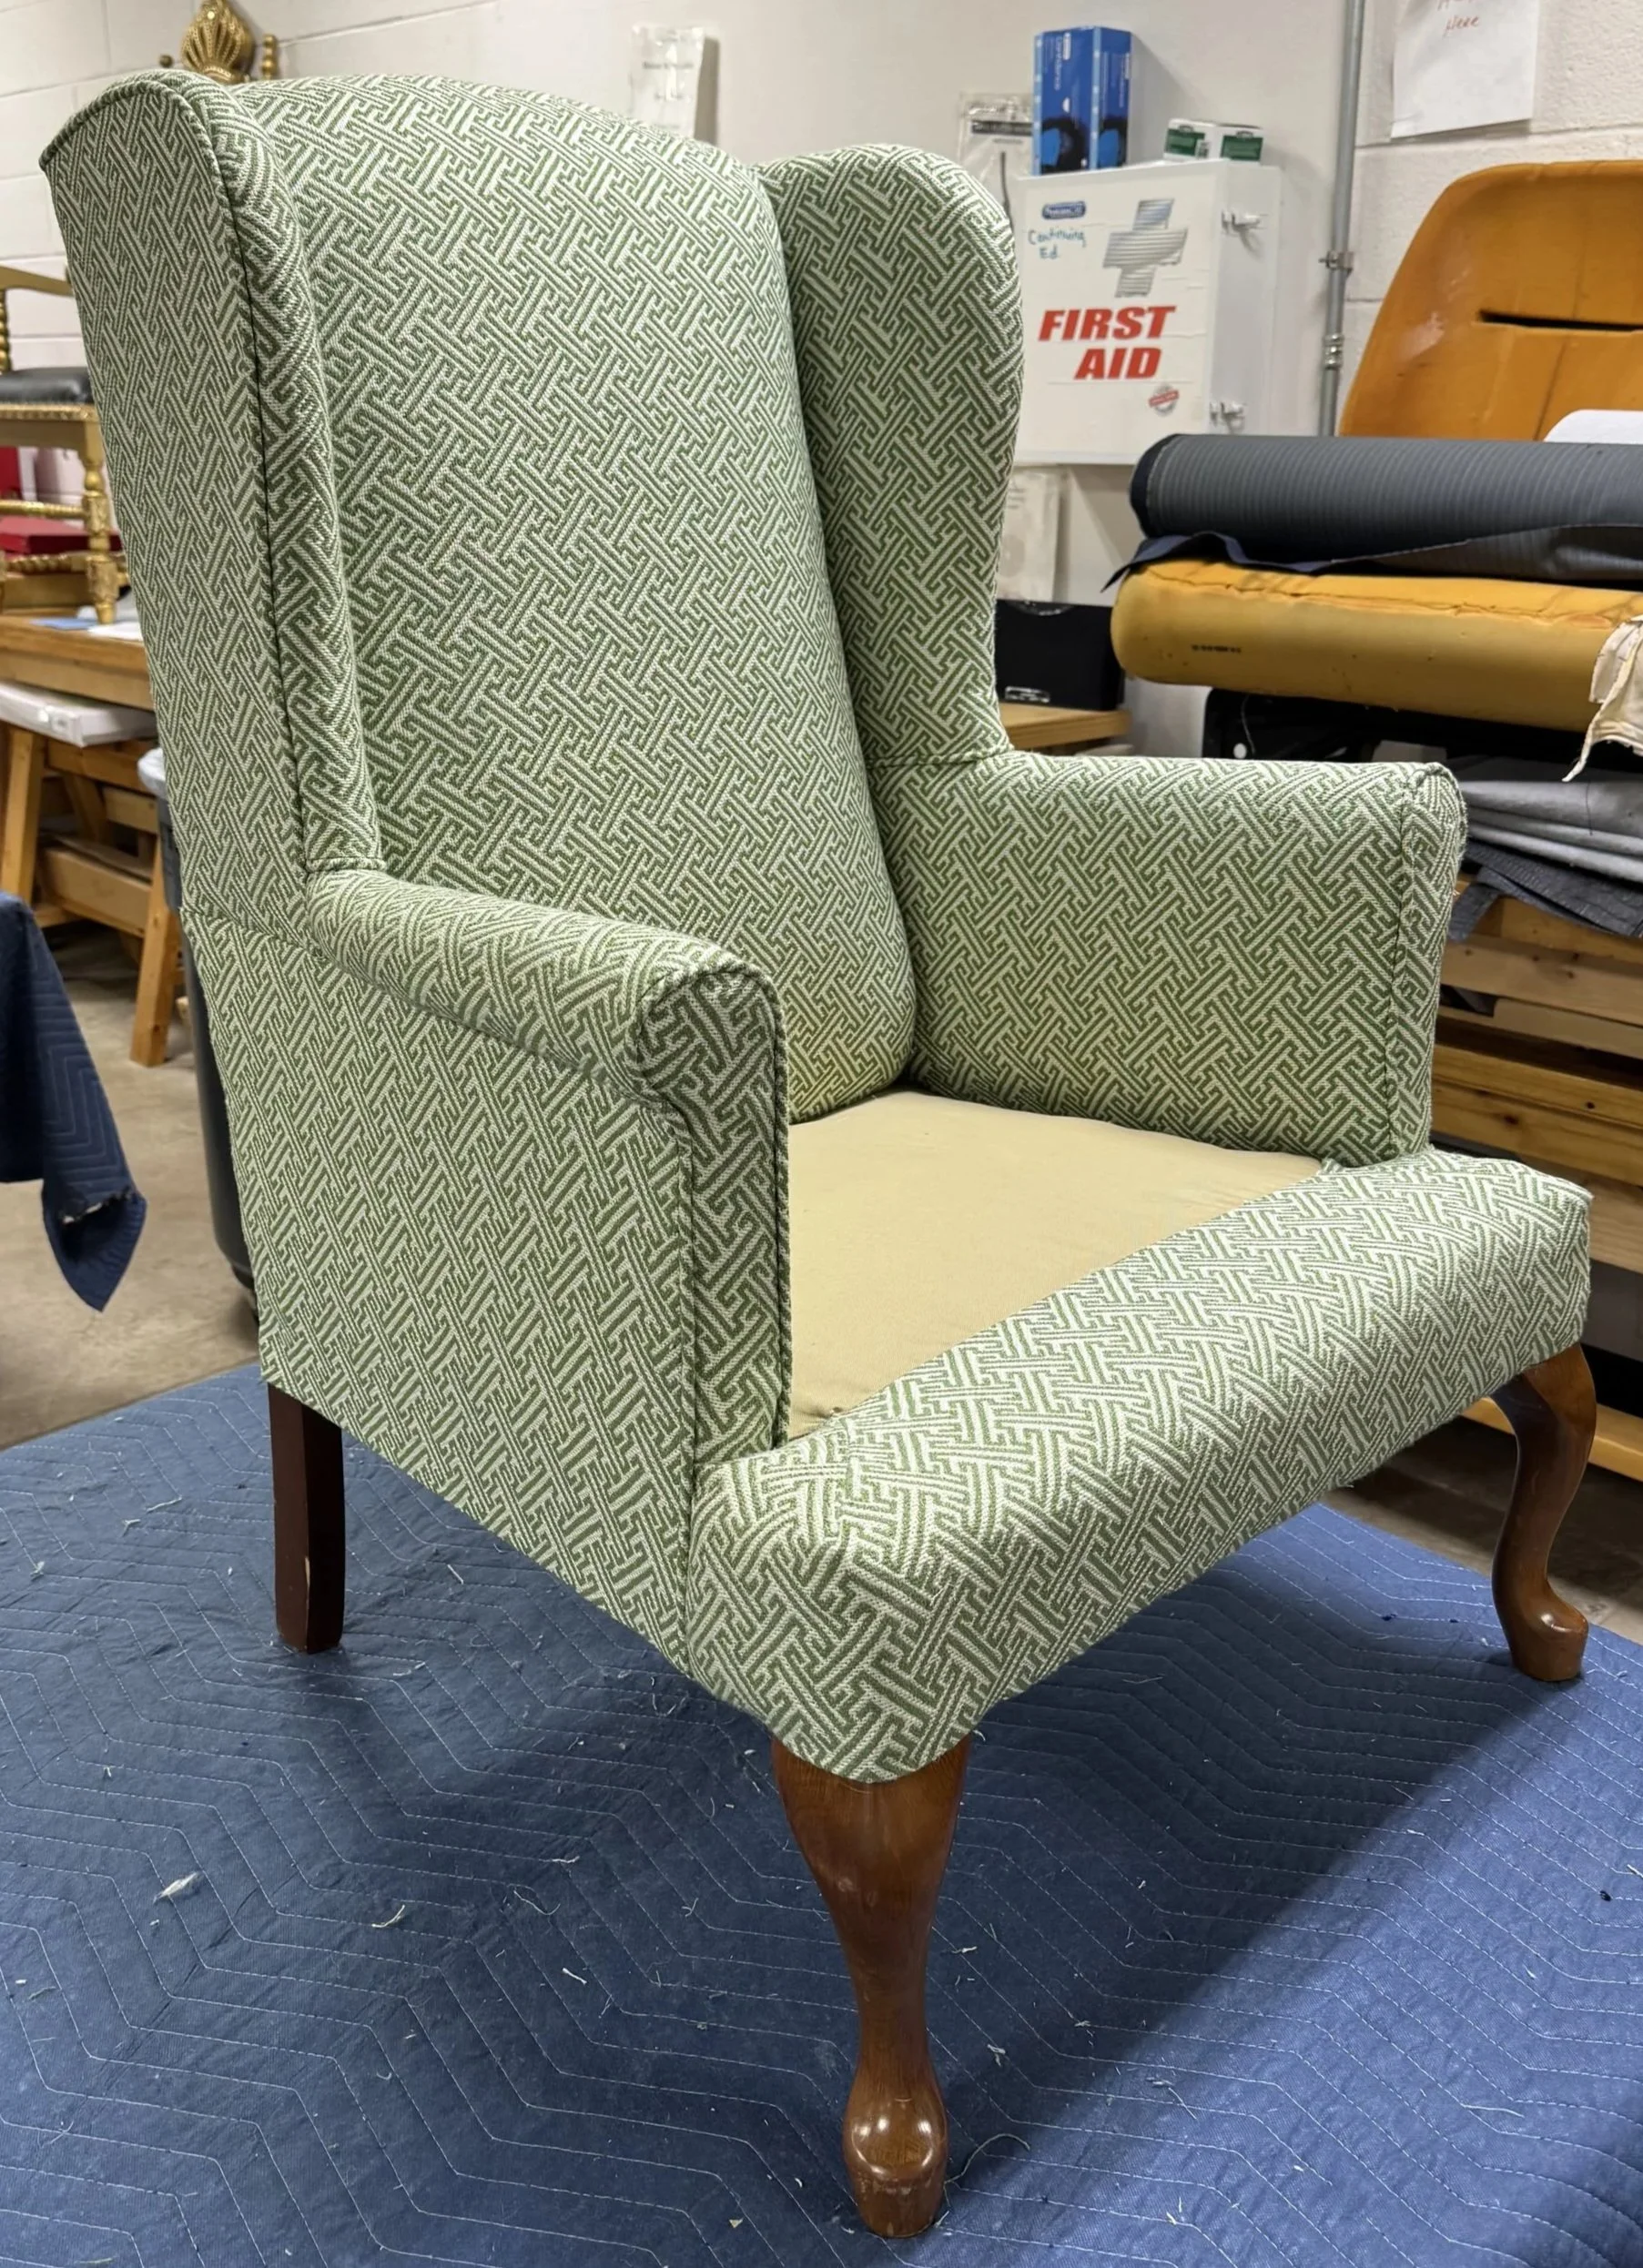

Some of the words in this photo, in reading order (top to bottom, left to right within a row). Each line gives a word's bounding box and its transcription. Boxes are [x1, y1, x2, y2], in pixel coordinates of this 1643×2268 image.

[1040, 244, 1059, 259] Ed
[1039, 306, 1177, 341] FIRST
[1074, 347, 1161, 380] AID
